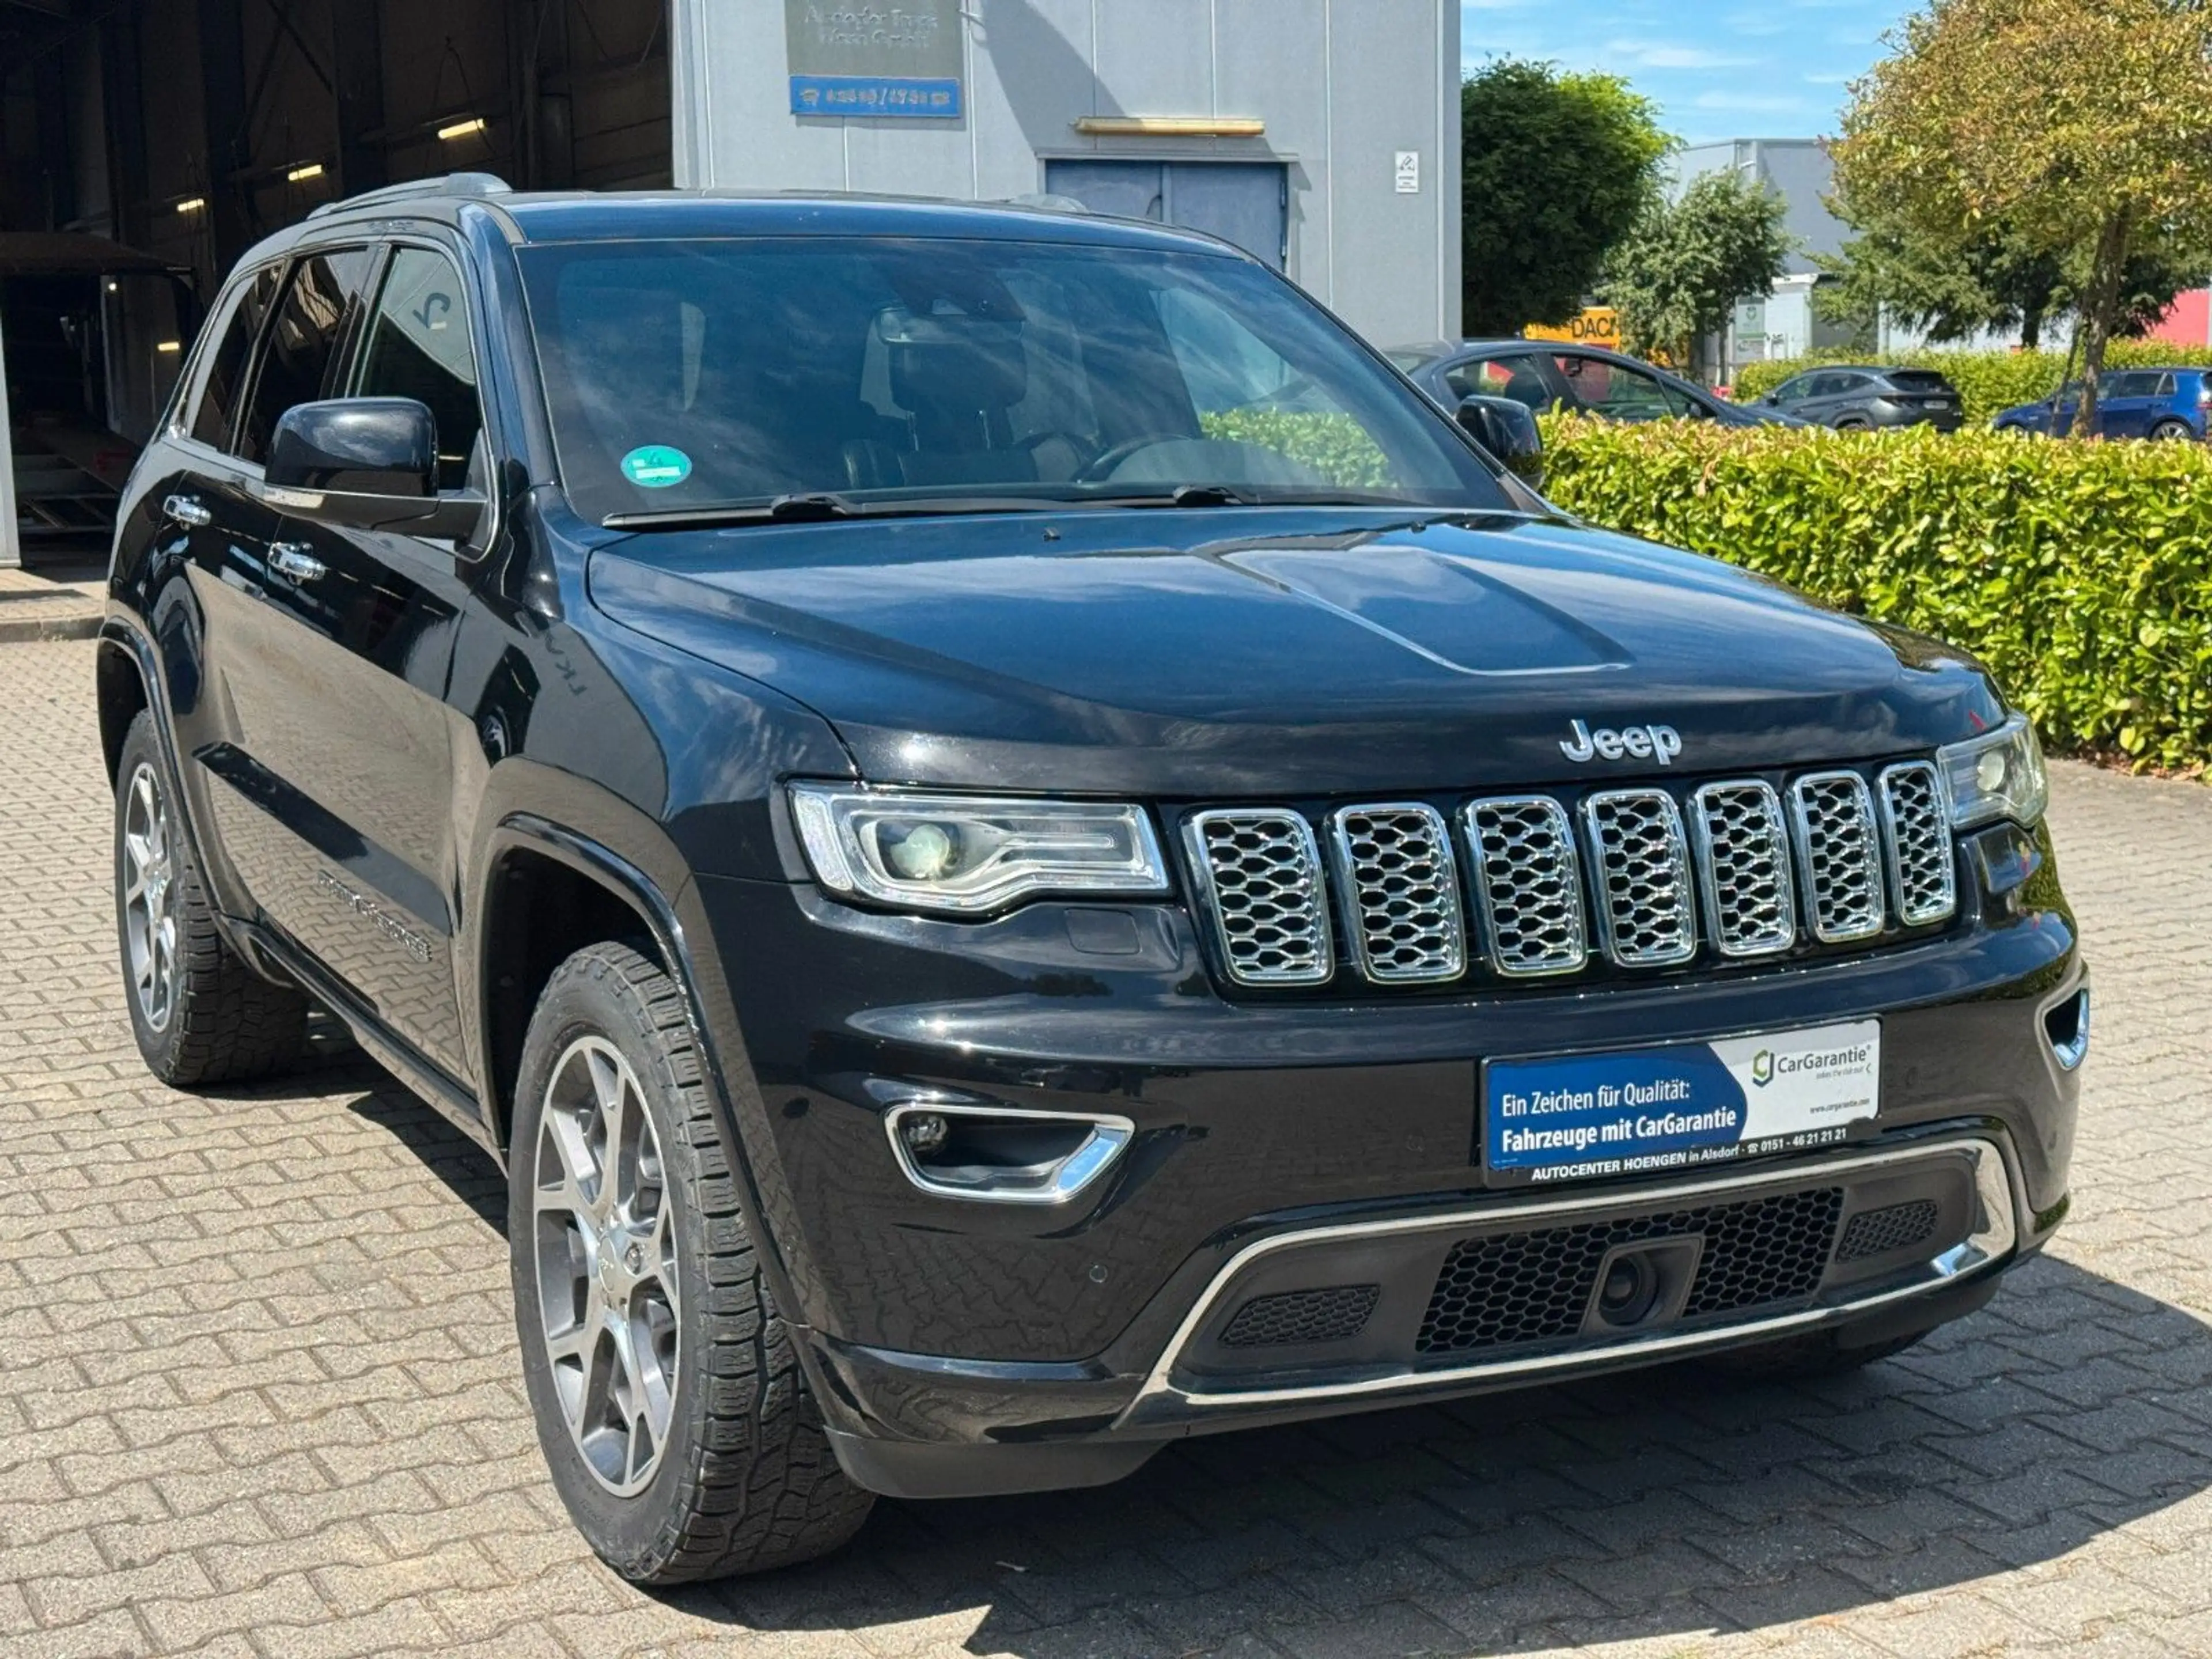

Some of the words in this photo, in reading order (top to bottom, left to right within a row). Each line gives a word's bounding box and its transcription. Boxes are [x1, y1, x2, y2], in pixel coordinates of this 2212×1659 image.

[1558, 719, 1682, 766] Jeep
[1503, 1093, 1527, 1116] Ein
[1531, 1088, 1593, 1114] Zeichen
[1597, 1085, 1620, 1108] für
[1624, 1079, 1690, 1106] Qualität:
[1502, 1128, 1597, 1152] Fahrzeuge
[1601, 1118, 1633, 1142] mit
[1636, 1106, 1736, 1137] CarGarantie
[1532, 1160, 1620, 1181] AUTOCENTER
[1624, 1152, 1687, 1170] HOENGEN
[1689, 1152, 1699, 1162] in
[1701, 1144, 1740, 1161] Alsdorf
[1761, 1138, 1783, 1152] 0151
[1793, 1135, 1805, 1146] 46
[1807, 1132, 1818, 1144] 21
[1821, 1130, 1832, 1142] 21
[1835, 1127, 1847, 1140] 21
